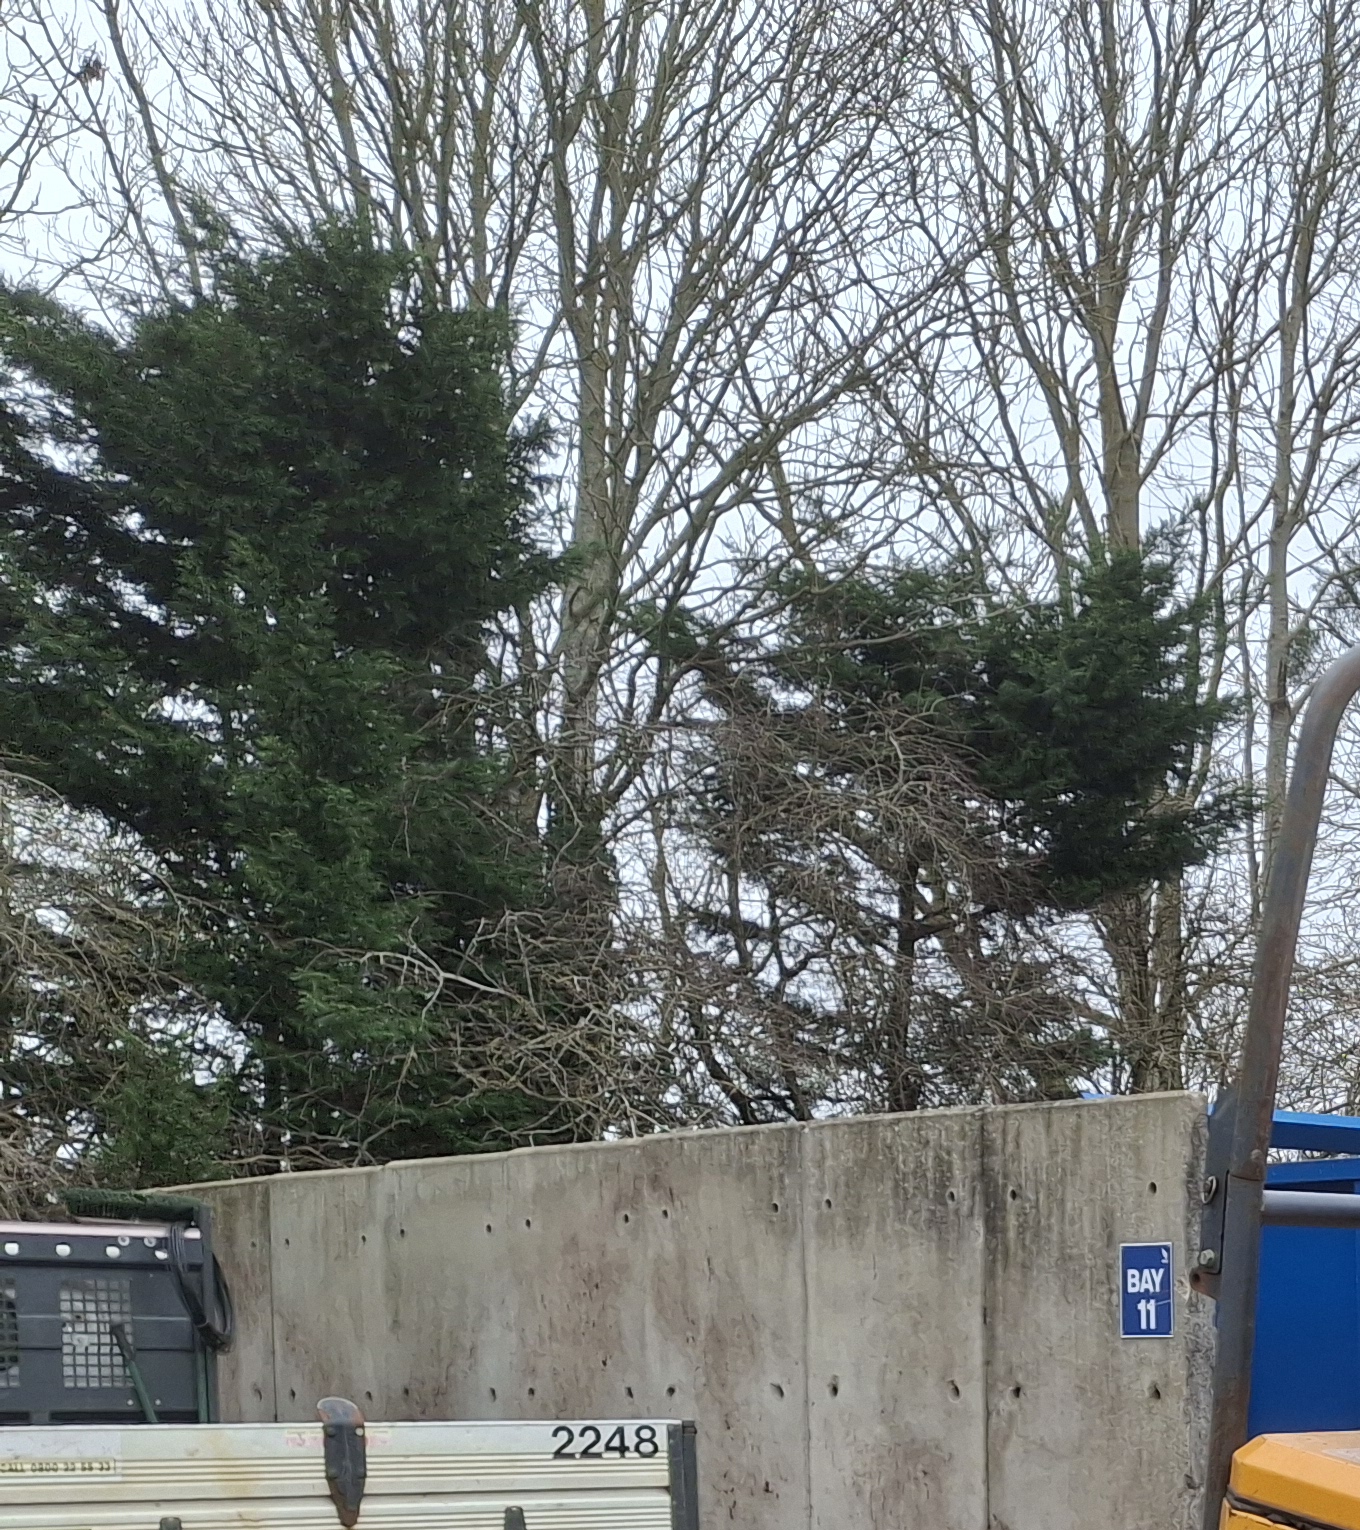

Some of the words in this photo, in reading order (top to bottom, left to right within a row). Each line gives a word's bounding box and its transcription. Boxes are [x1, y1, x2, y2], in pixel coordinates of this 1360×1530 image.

[1127, 1268, 1165, 1293] BAY
[1137, 1299, 1156, 1329] 11
[552, 1425, 659, 1458] 2248
